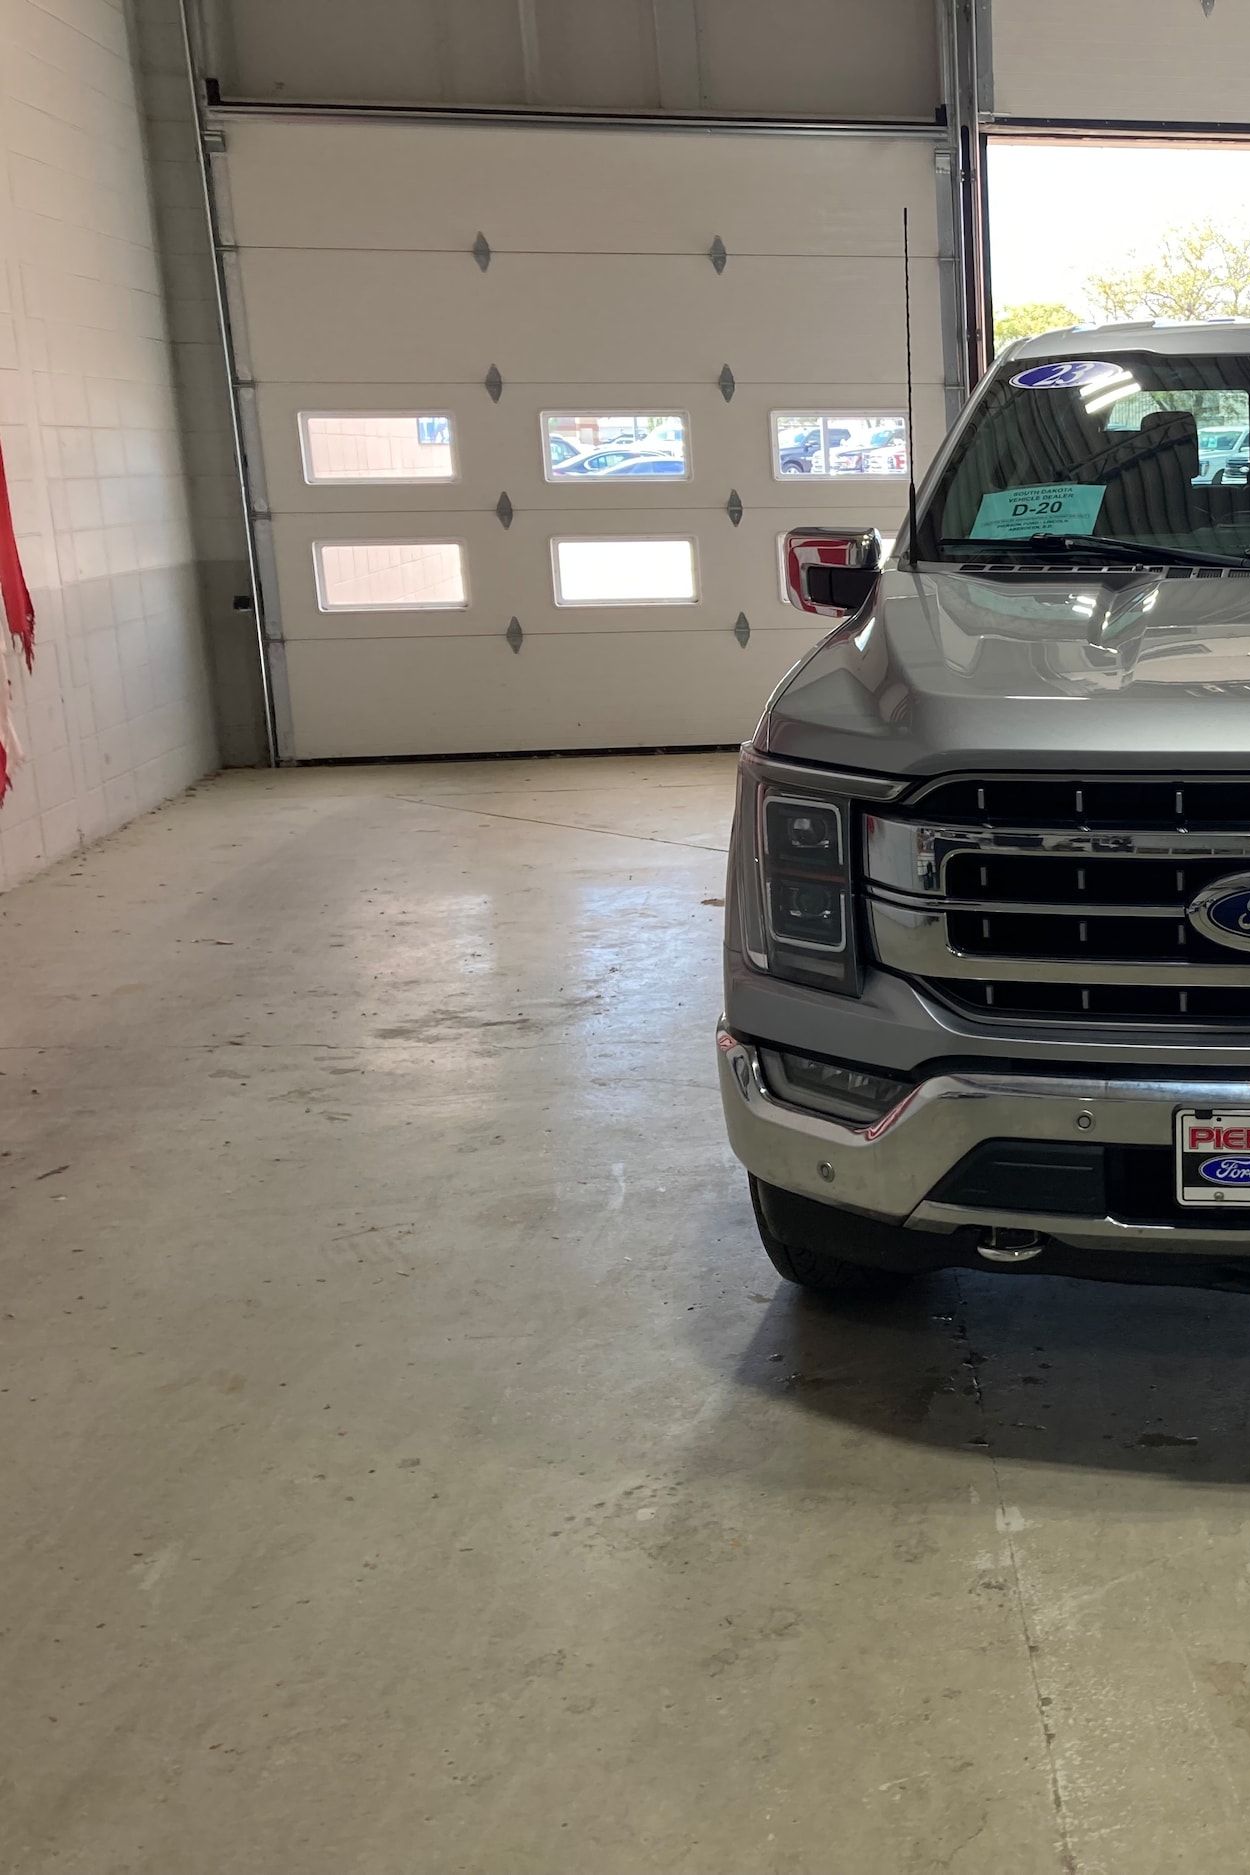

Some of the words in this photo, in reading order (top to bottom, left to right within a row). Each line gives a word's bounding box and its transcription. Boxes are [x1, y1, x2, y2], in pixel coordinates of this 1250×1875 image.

[1032, 363, 1096, 386] 23
[1041, 487, 1073, 495] DAKOTA
[1008, 495, 1040, 503] VEHICLE
[1012, 501, 1063, 516] D-20
